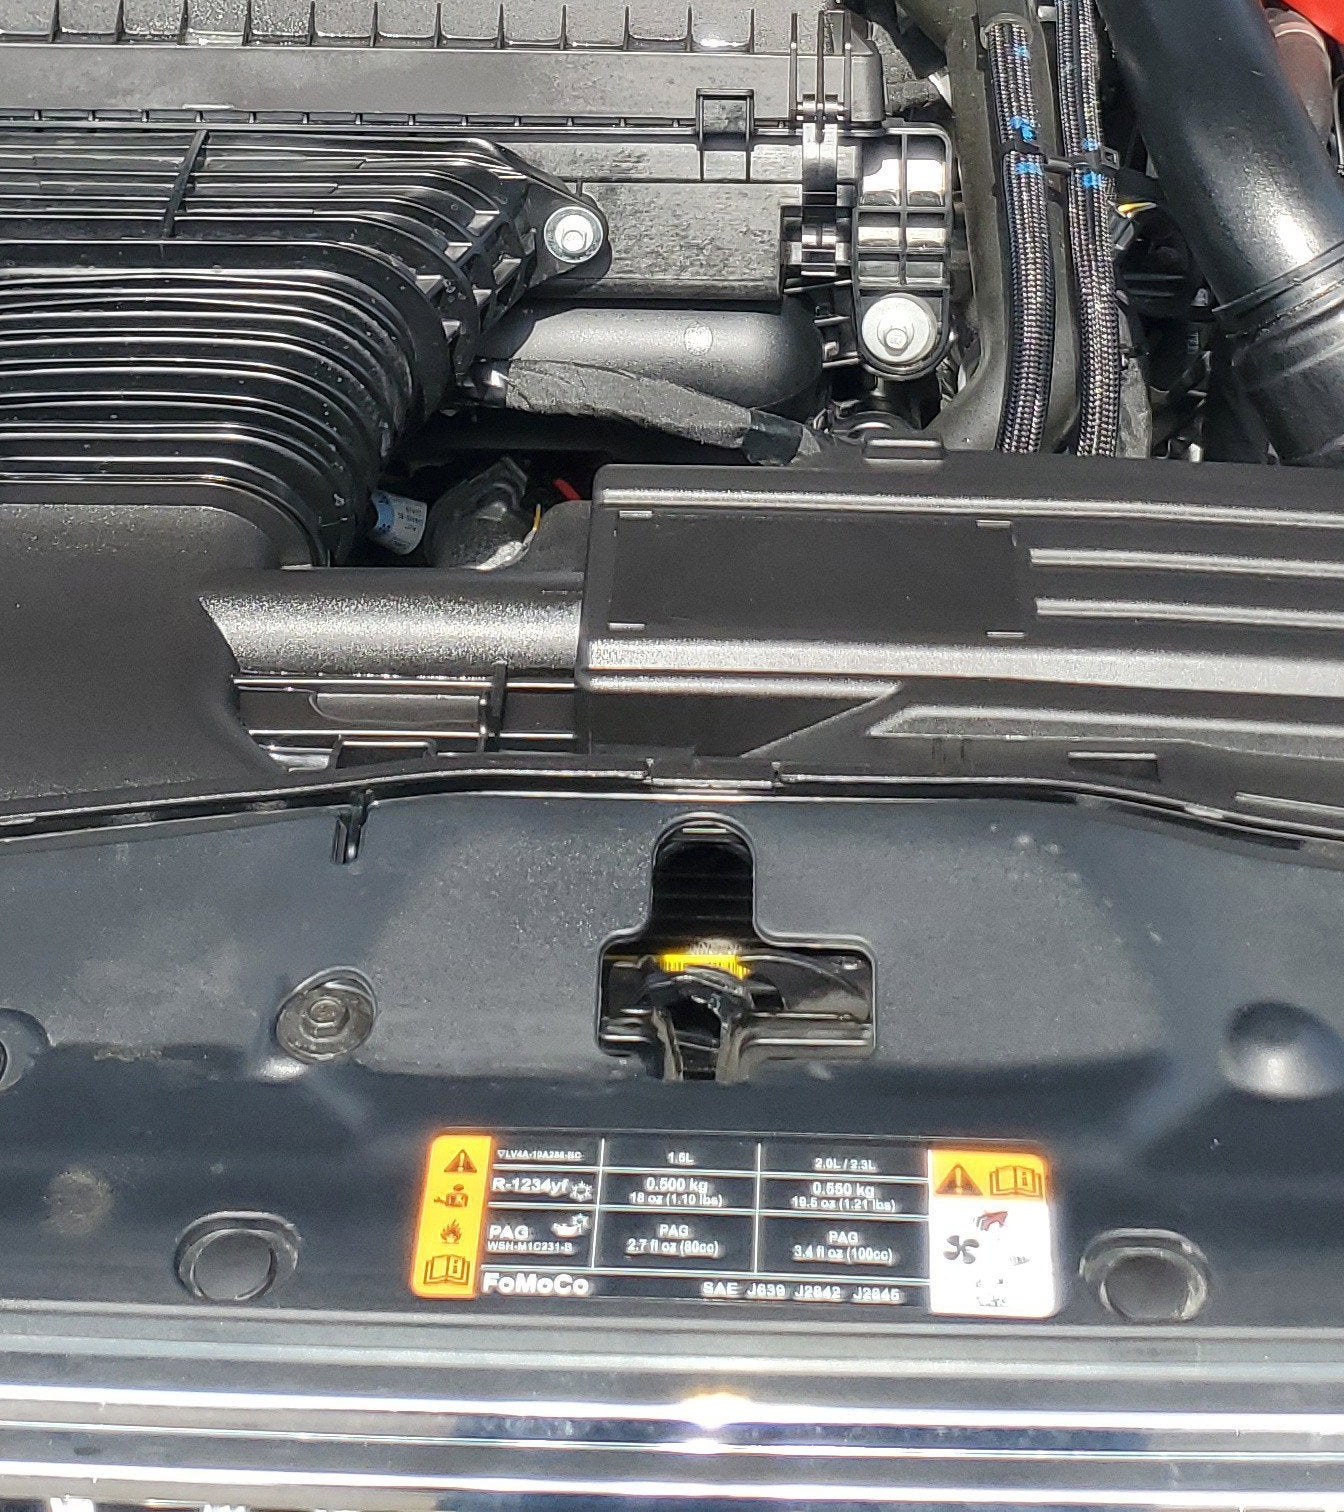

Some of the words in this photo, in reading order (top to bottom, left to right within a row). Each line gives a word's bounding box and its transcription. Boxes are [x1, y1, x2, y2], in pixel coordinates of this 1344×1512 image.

[814, 1157, 842, 1169] 2.0L
[491, 1177, 569, 1197] R-1234yf
[645, 1176, 686, 1192] 0.500
[689, 1177, 708, 1194] kg
[855, 1182, 875, 1198] kg
[629, 1191, 645, 1204] 18
[647, 1195, 664, 1204] oz
[666, 1193, 696, 1206] (1.10
[699, 1193, 723, 1207] lbs)
[820, 1199, 836, 1208] oz
[839, 1197, 868, 1211] (1.21
[871, 1198, 896, 1212] lbs)
[488, 1224, 529, 1239] PAG
[659, 1223, 689, 1237] PAG
[828, 1230, 859, 1244] PAG
[627, 1238, 647, 1253] 2.7
[650, 1239, 659, 1253] fl
[661, 1242, 677, 1253] oz
[816, 1246, 825, 1259] fl
[827, 1249, 844, 1260] oz
[846, 1248, 893, 1264] (100cc)
[482, 1272, 590, 1295] FoMoCo
[702, 1281, 738, 1295] SAE
